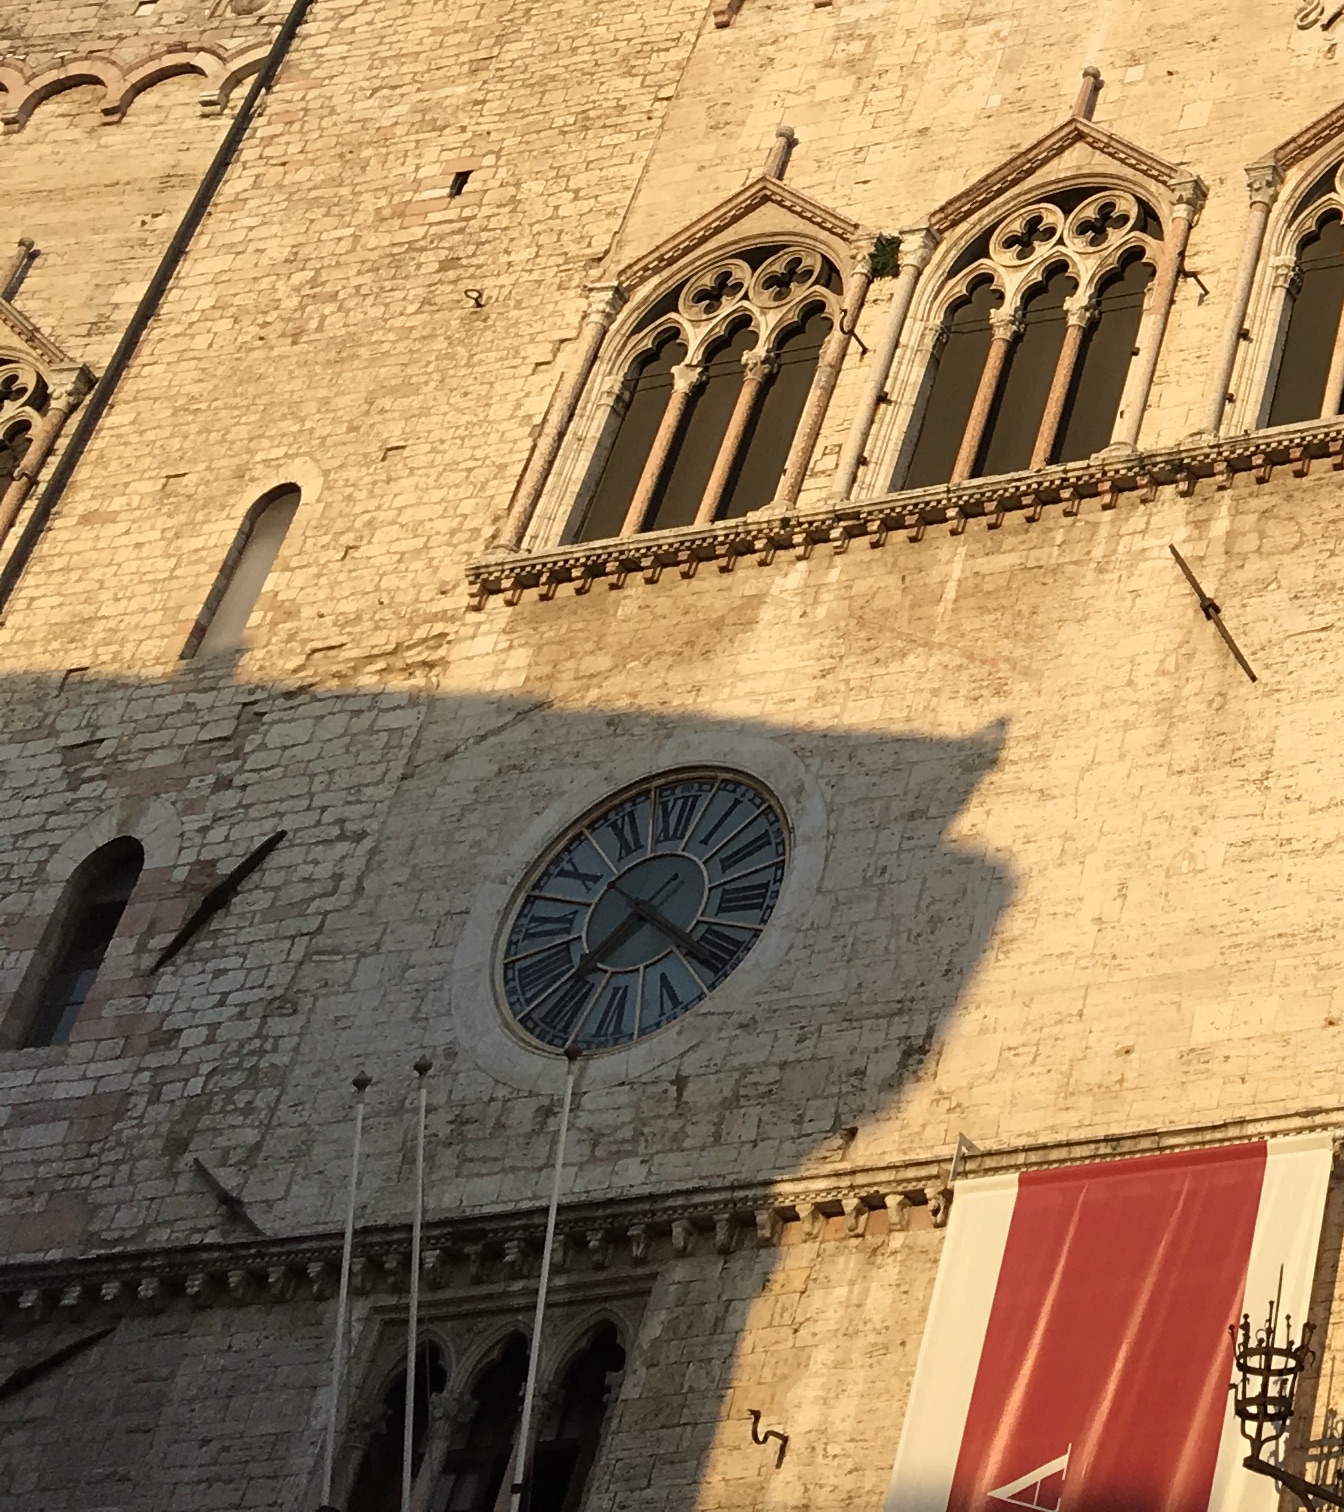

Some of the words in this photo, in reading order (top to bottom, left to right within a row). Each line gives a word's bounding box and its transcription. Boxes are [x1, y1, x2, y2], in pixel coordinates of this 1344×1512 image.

[608, 810, 644, 862] XI
[655, 795, 702, 844] XII
[699, 798, 743, 845] I
[554, 851, 605, 893] X
[719, 830, 773, 873] II
[716, 880, 771, 916] III
[522, 909, 579, 941] IX
[591, 985, 629, 1037] VI
[658, 972, 684, 1018] V
